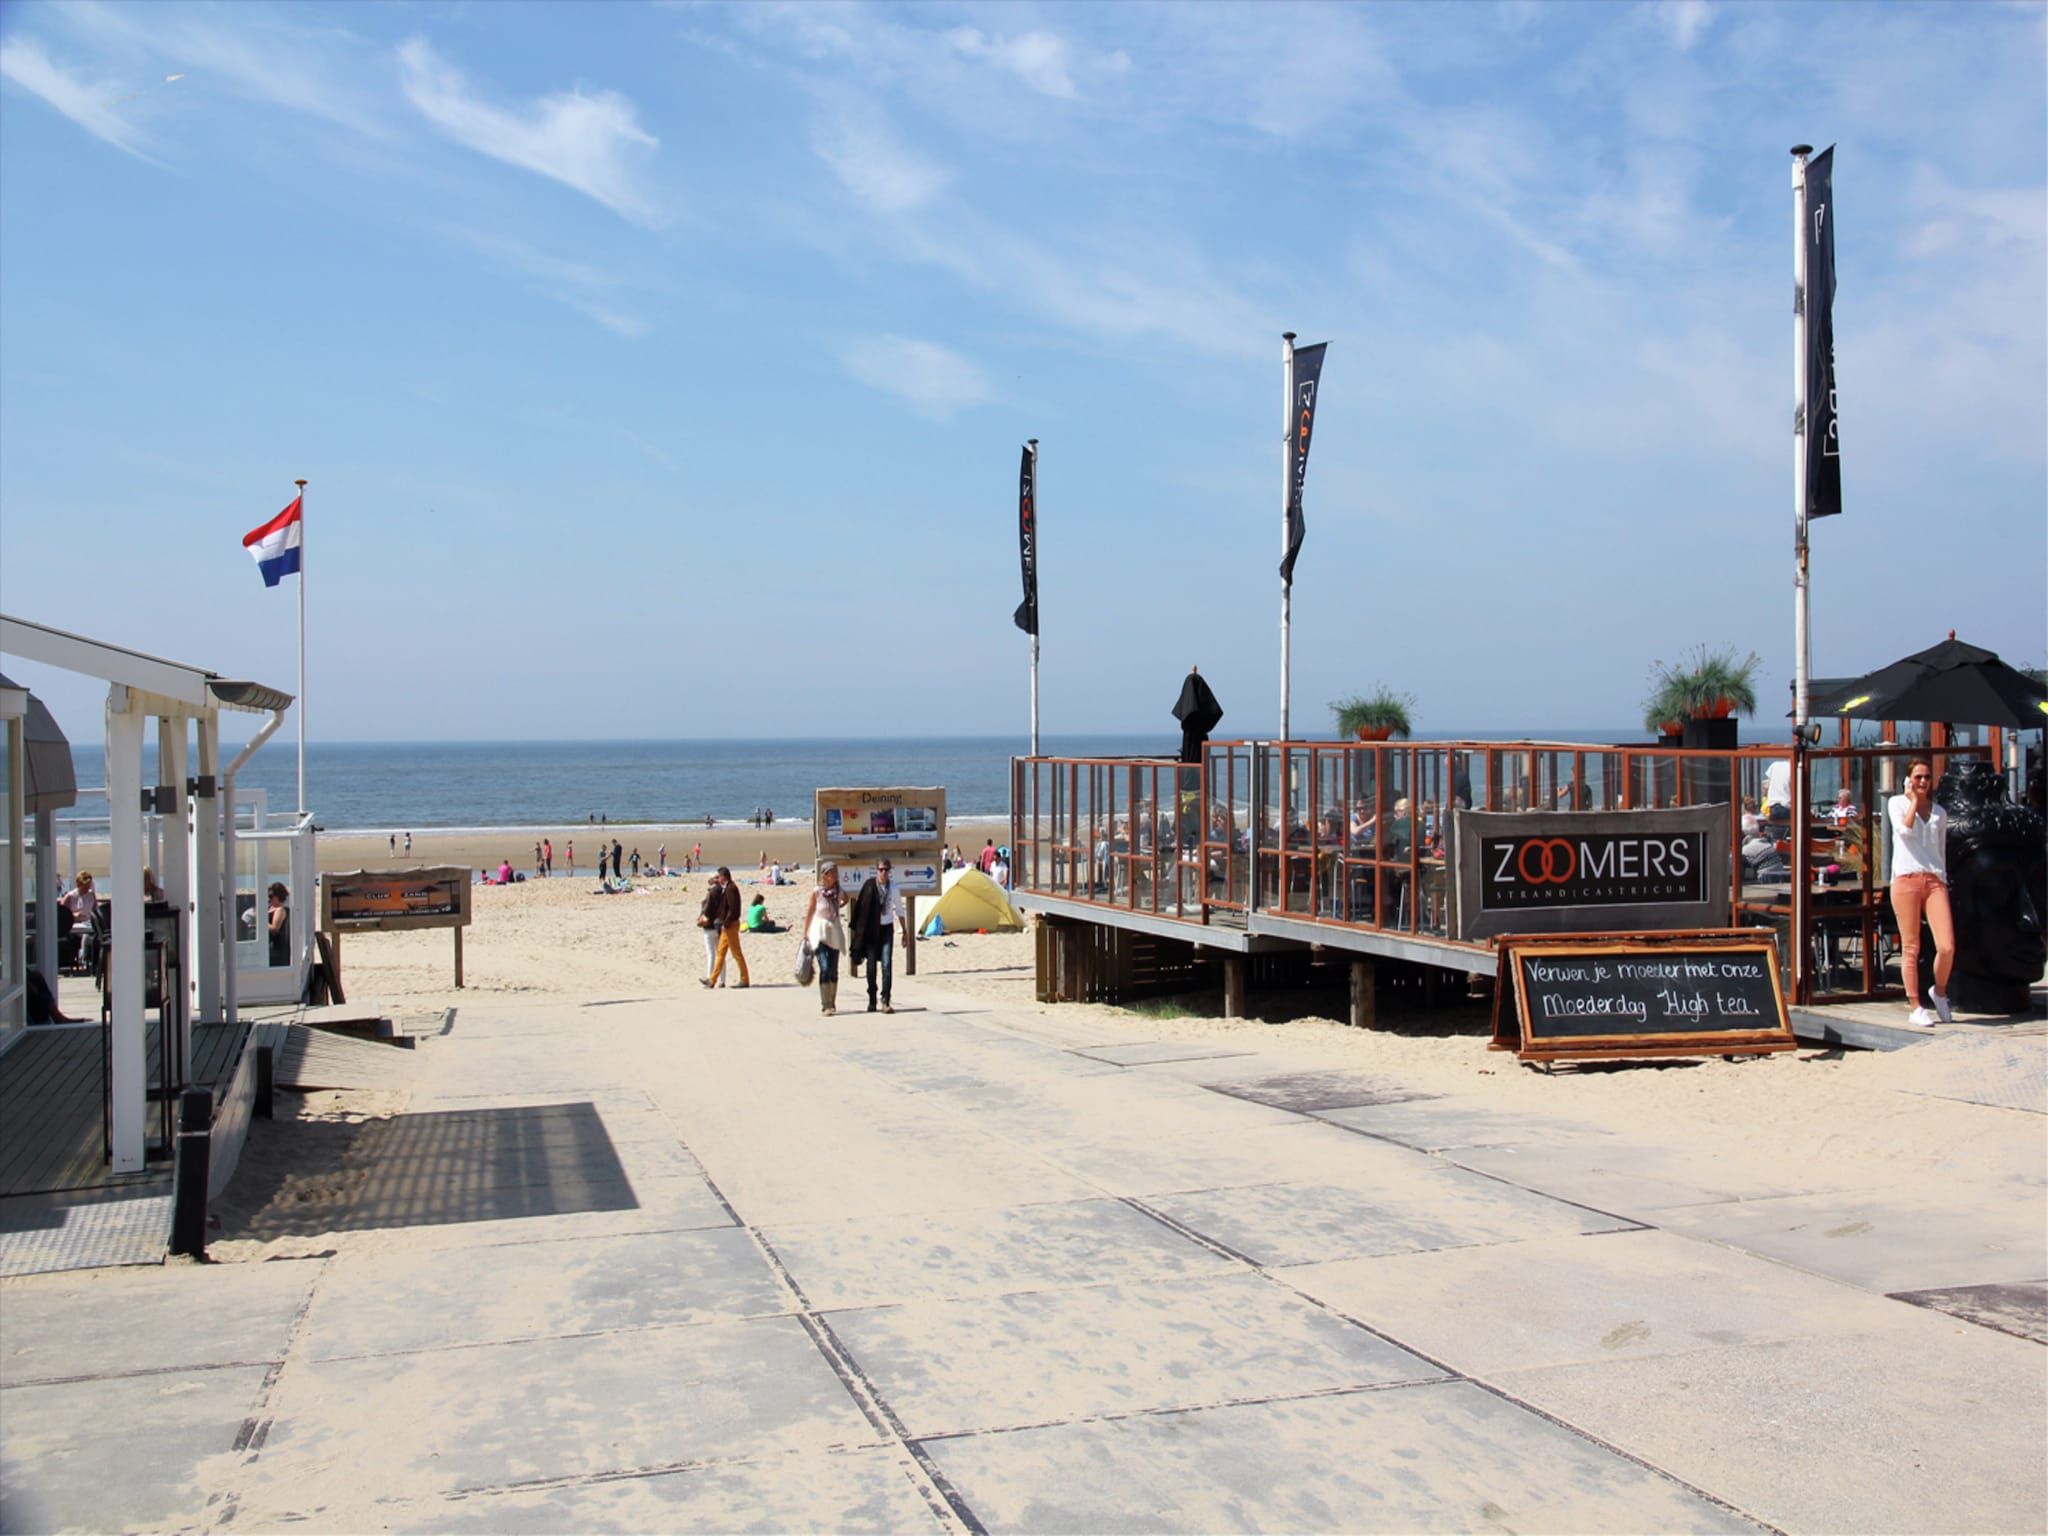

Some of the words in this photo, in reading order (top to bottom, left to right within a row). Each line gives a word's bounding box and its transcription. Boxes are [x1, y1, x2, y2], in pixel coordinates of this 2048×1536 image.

[861, 791, 902, 805] Deining
[1493, 838, 1690, 884] ZOOMERS
[1496, 888, 1566, 899] STRAND
[1582, 885, 1687, 897] CASTRICUM
[1525, 960, 1590, 983] Verwen
[1592, 961, 1612, 984] je
[1617, 963, 1679, 979] moeder
[1683, 958, 1719, 978] met
[1721, 963, 1764, 978] onze
[1543, 992, 1647, 1023] Moederdag
[1656, 989, 1710, 1023] High
[1716, 991, 1760, 1015] tea.
